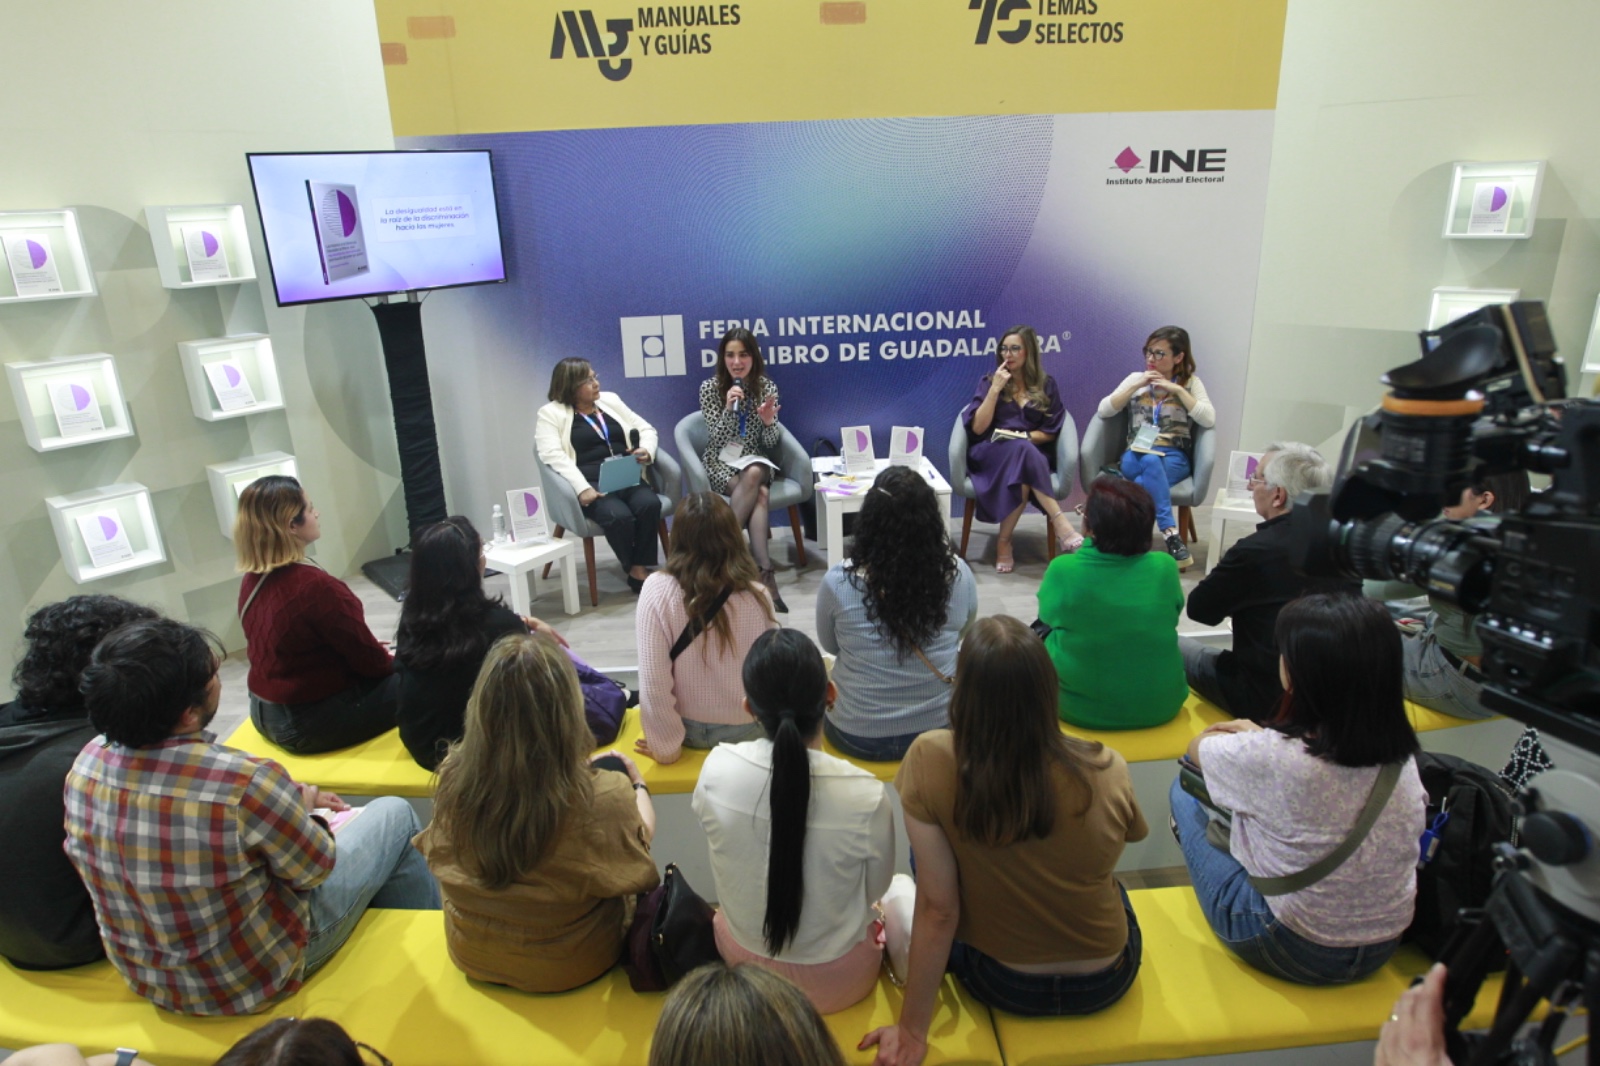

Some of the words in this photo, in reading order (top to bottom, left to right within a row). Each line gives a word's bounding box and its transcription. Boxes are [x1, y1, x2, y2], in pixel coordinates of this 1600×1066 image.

[638, 4, 741, 28] MANUALES
[1038, 0, 1098, 16] TEMAS
[639, 35, 650, 56] Y
[654, 29, 712, 56] GUÍAS
[1035, 21, 1124, 44] SELECTOS
[1149, 148, 1227, 173] INE
[1145, 176, 1184, 185] Nacional
[1185, 175, 1225, 184] Electoral
[395, 206, 437, 215] desigualdad
[778, 309, 986, 337] INTERNACIONAL
[839, 342, 870, 362] DE
